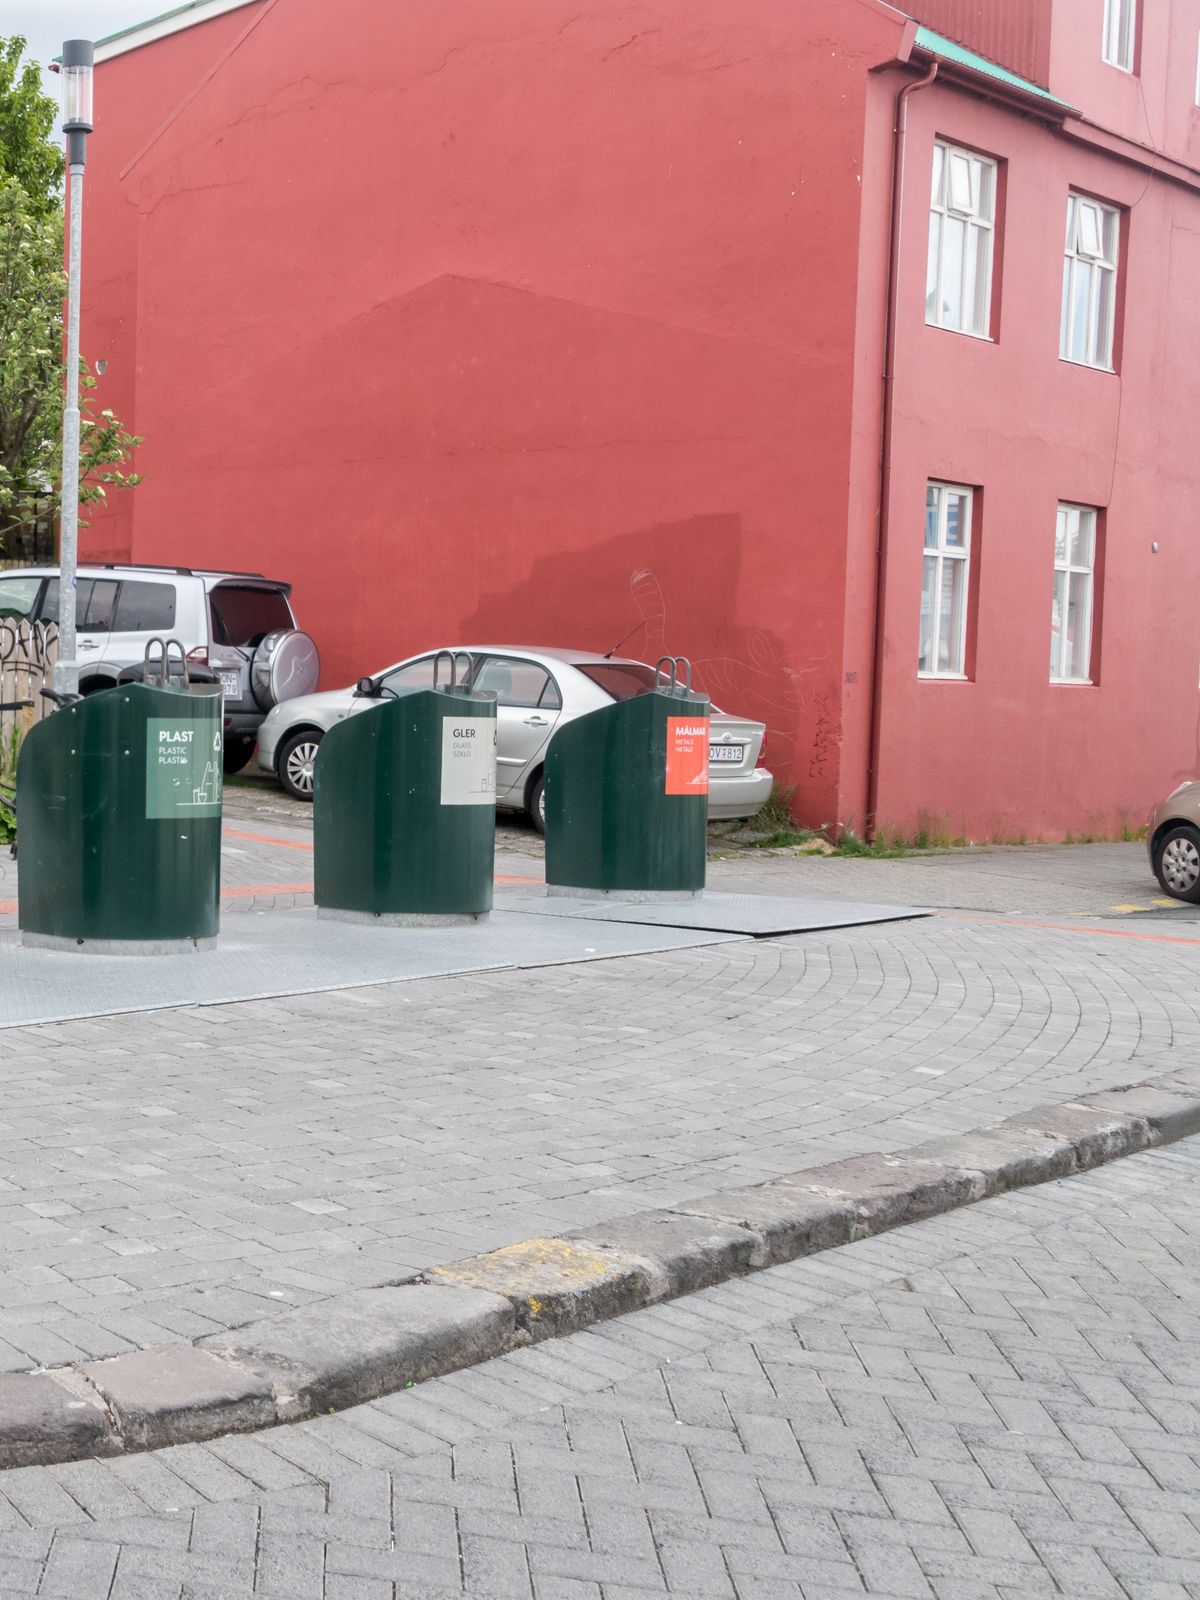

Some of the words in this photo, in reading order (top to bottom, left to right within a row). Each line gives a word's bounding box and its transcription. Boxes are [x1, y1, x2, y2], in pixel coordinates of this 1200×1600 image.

[159, 730, 194, 742] PLAST
[453, 728, 476, 738] GLER
[158, 746, 187, 755] PLASTIC
[452, 742, 472, 750] GLASS
